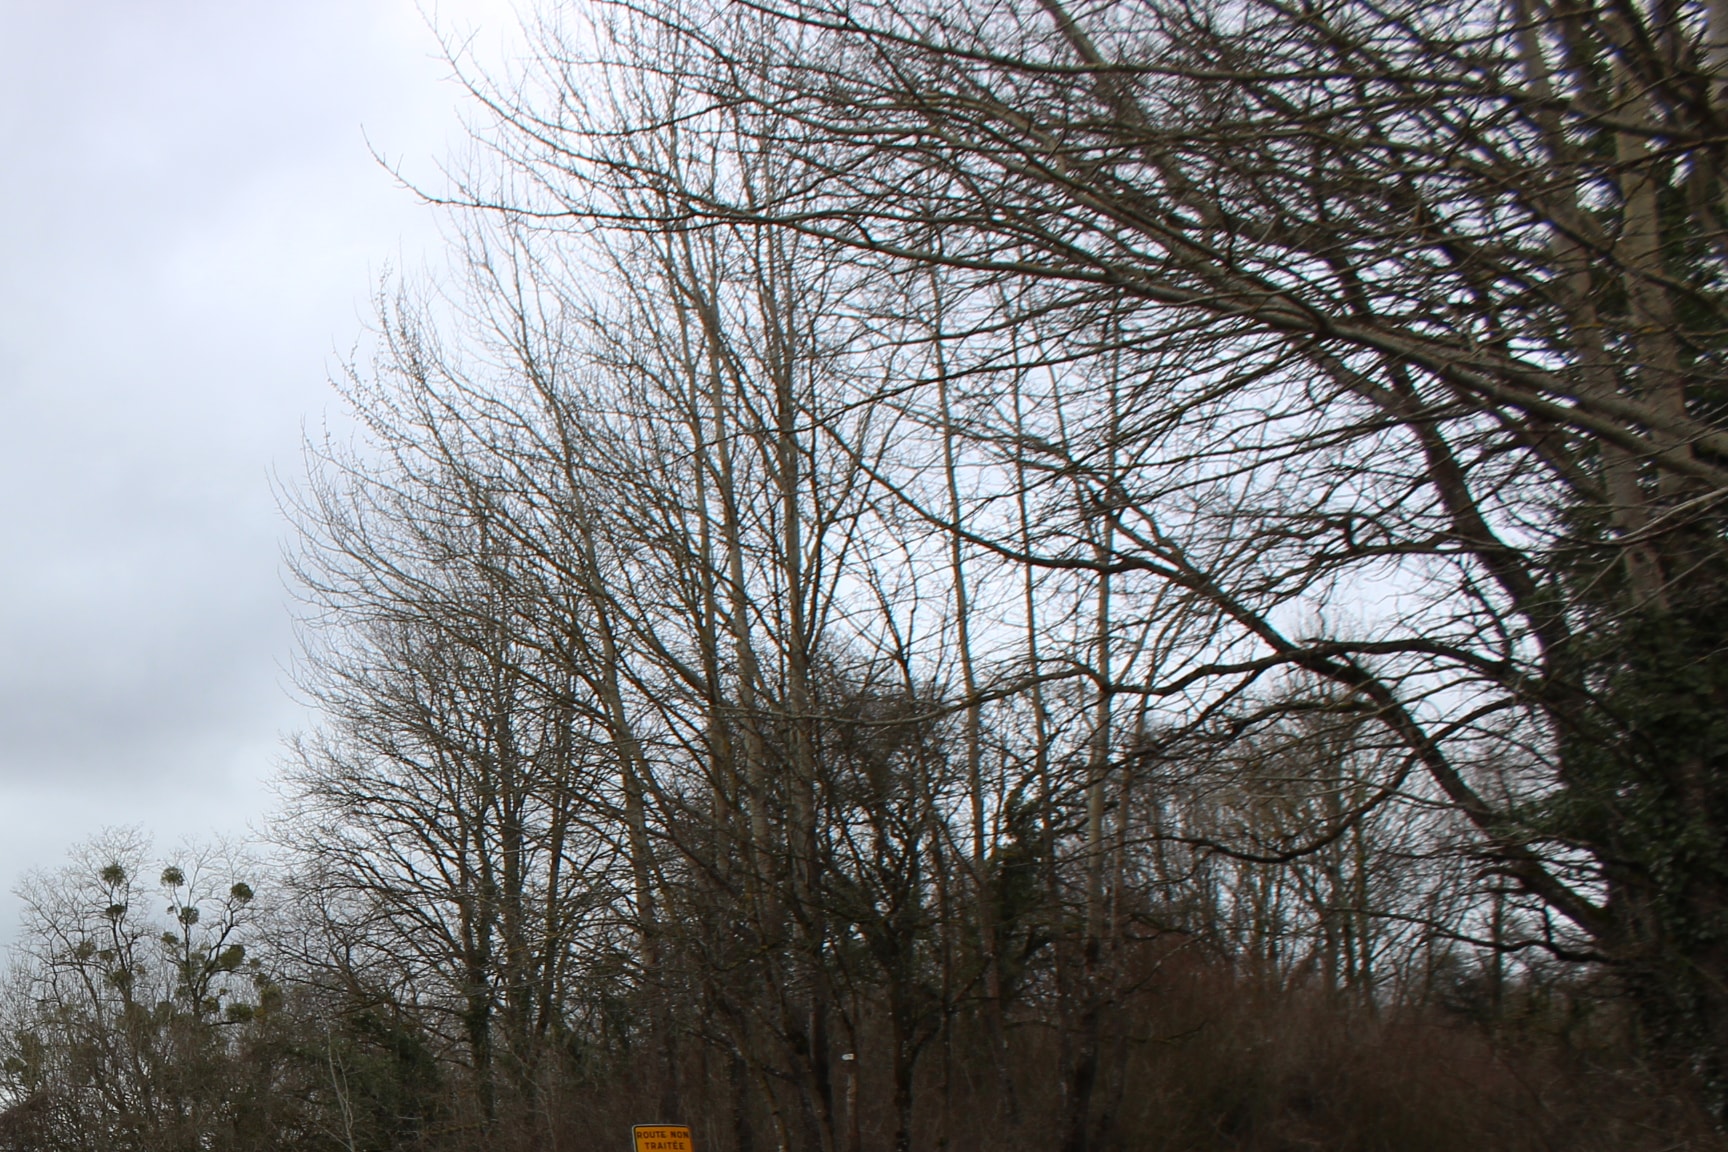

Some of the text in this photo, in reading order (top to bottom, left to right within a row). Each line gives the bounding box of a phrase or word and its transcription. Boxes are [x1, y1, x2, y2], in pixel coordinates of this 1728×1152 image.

[636, 1130, 690, 1139] ROUTE NON
[644, 1140, 685, 1150] TRAITÉE
